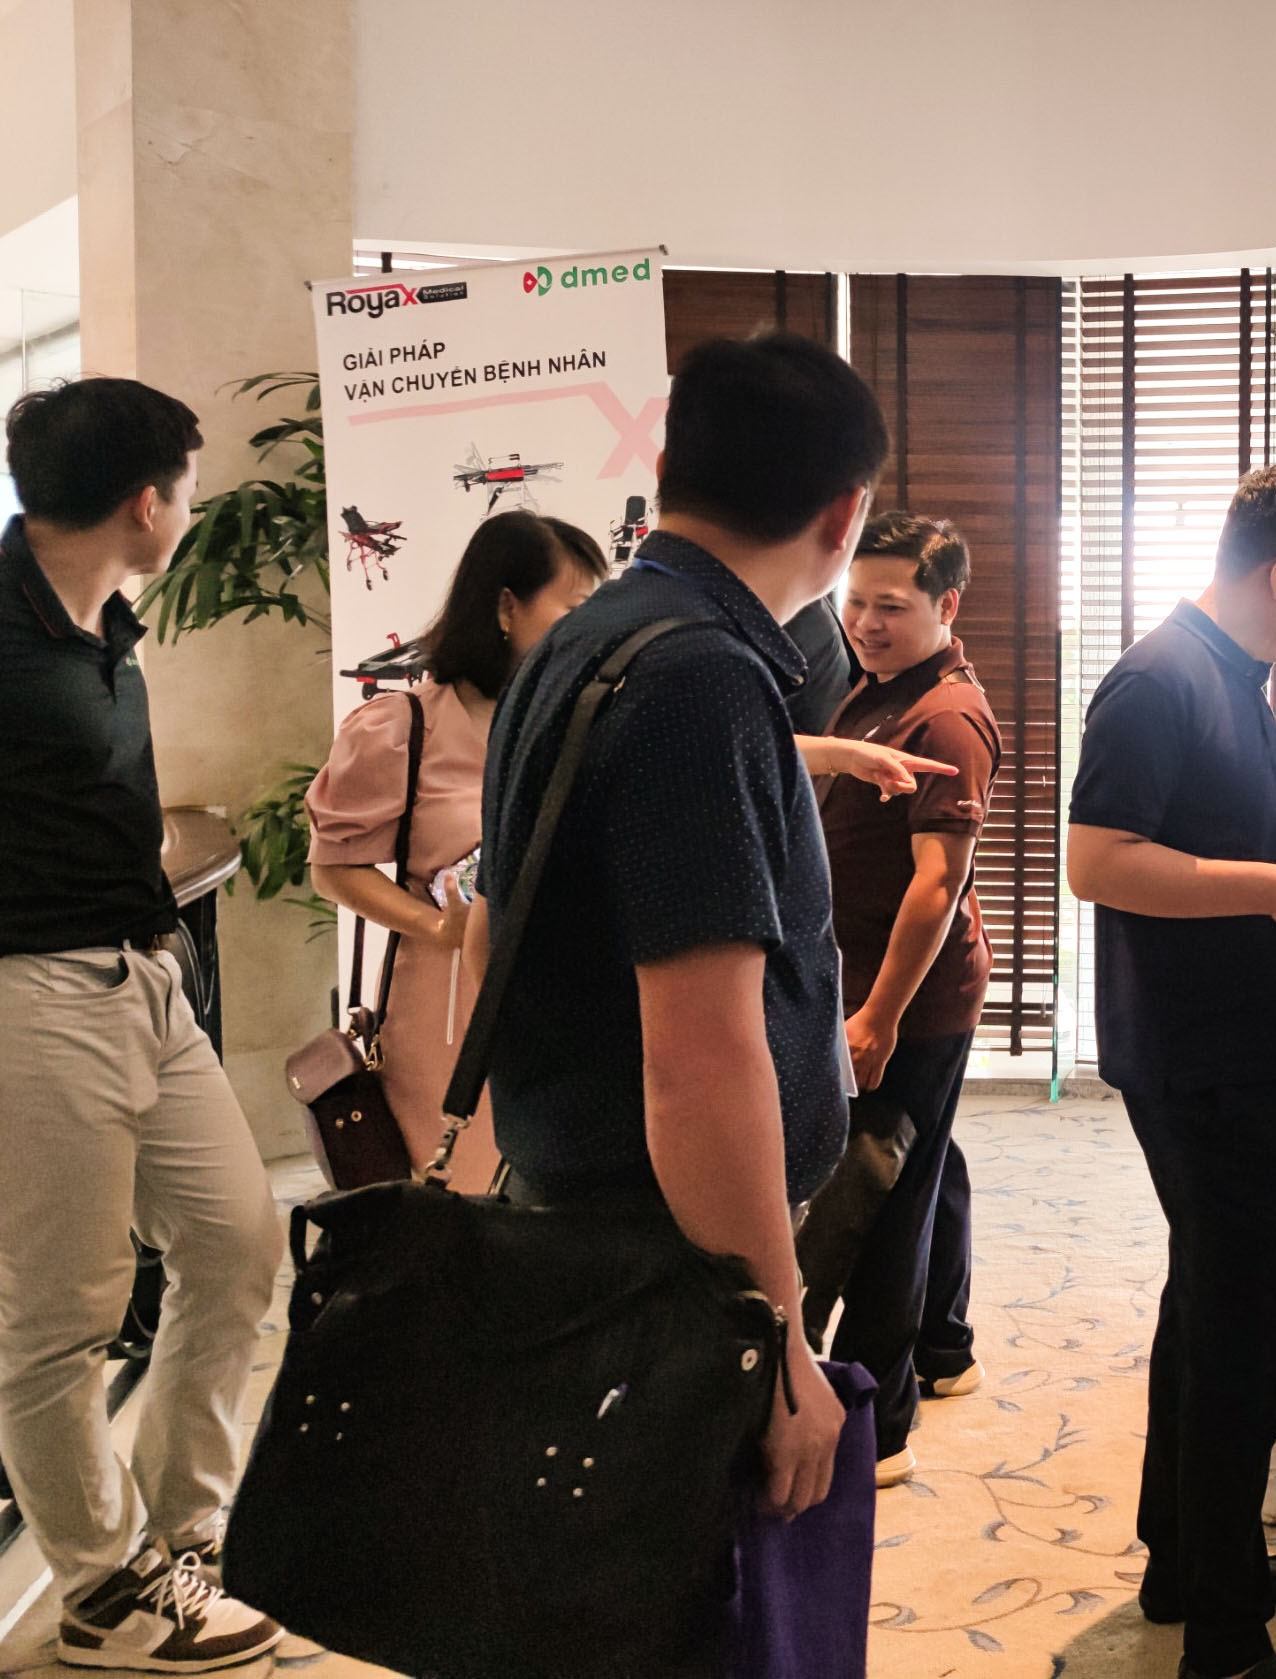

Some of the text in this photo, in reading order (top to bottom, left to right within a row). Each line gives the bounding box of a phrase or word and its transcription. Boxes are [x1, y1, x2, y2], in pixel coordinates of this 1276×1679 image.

[561, 258, 650, 289] dmed
[389, 339, 446, 364] PHÁP
[484, 360, 541, 384] BỆNH
[548, 348, 607, 374] NHÂN
